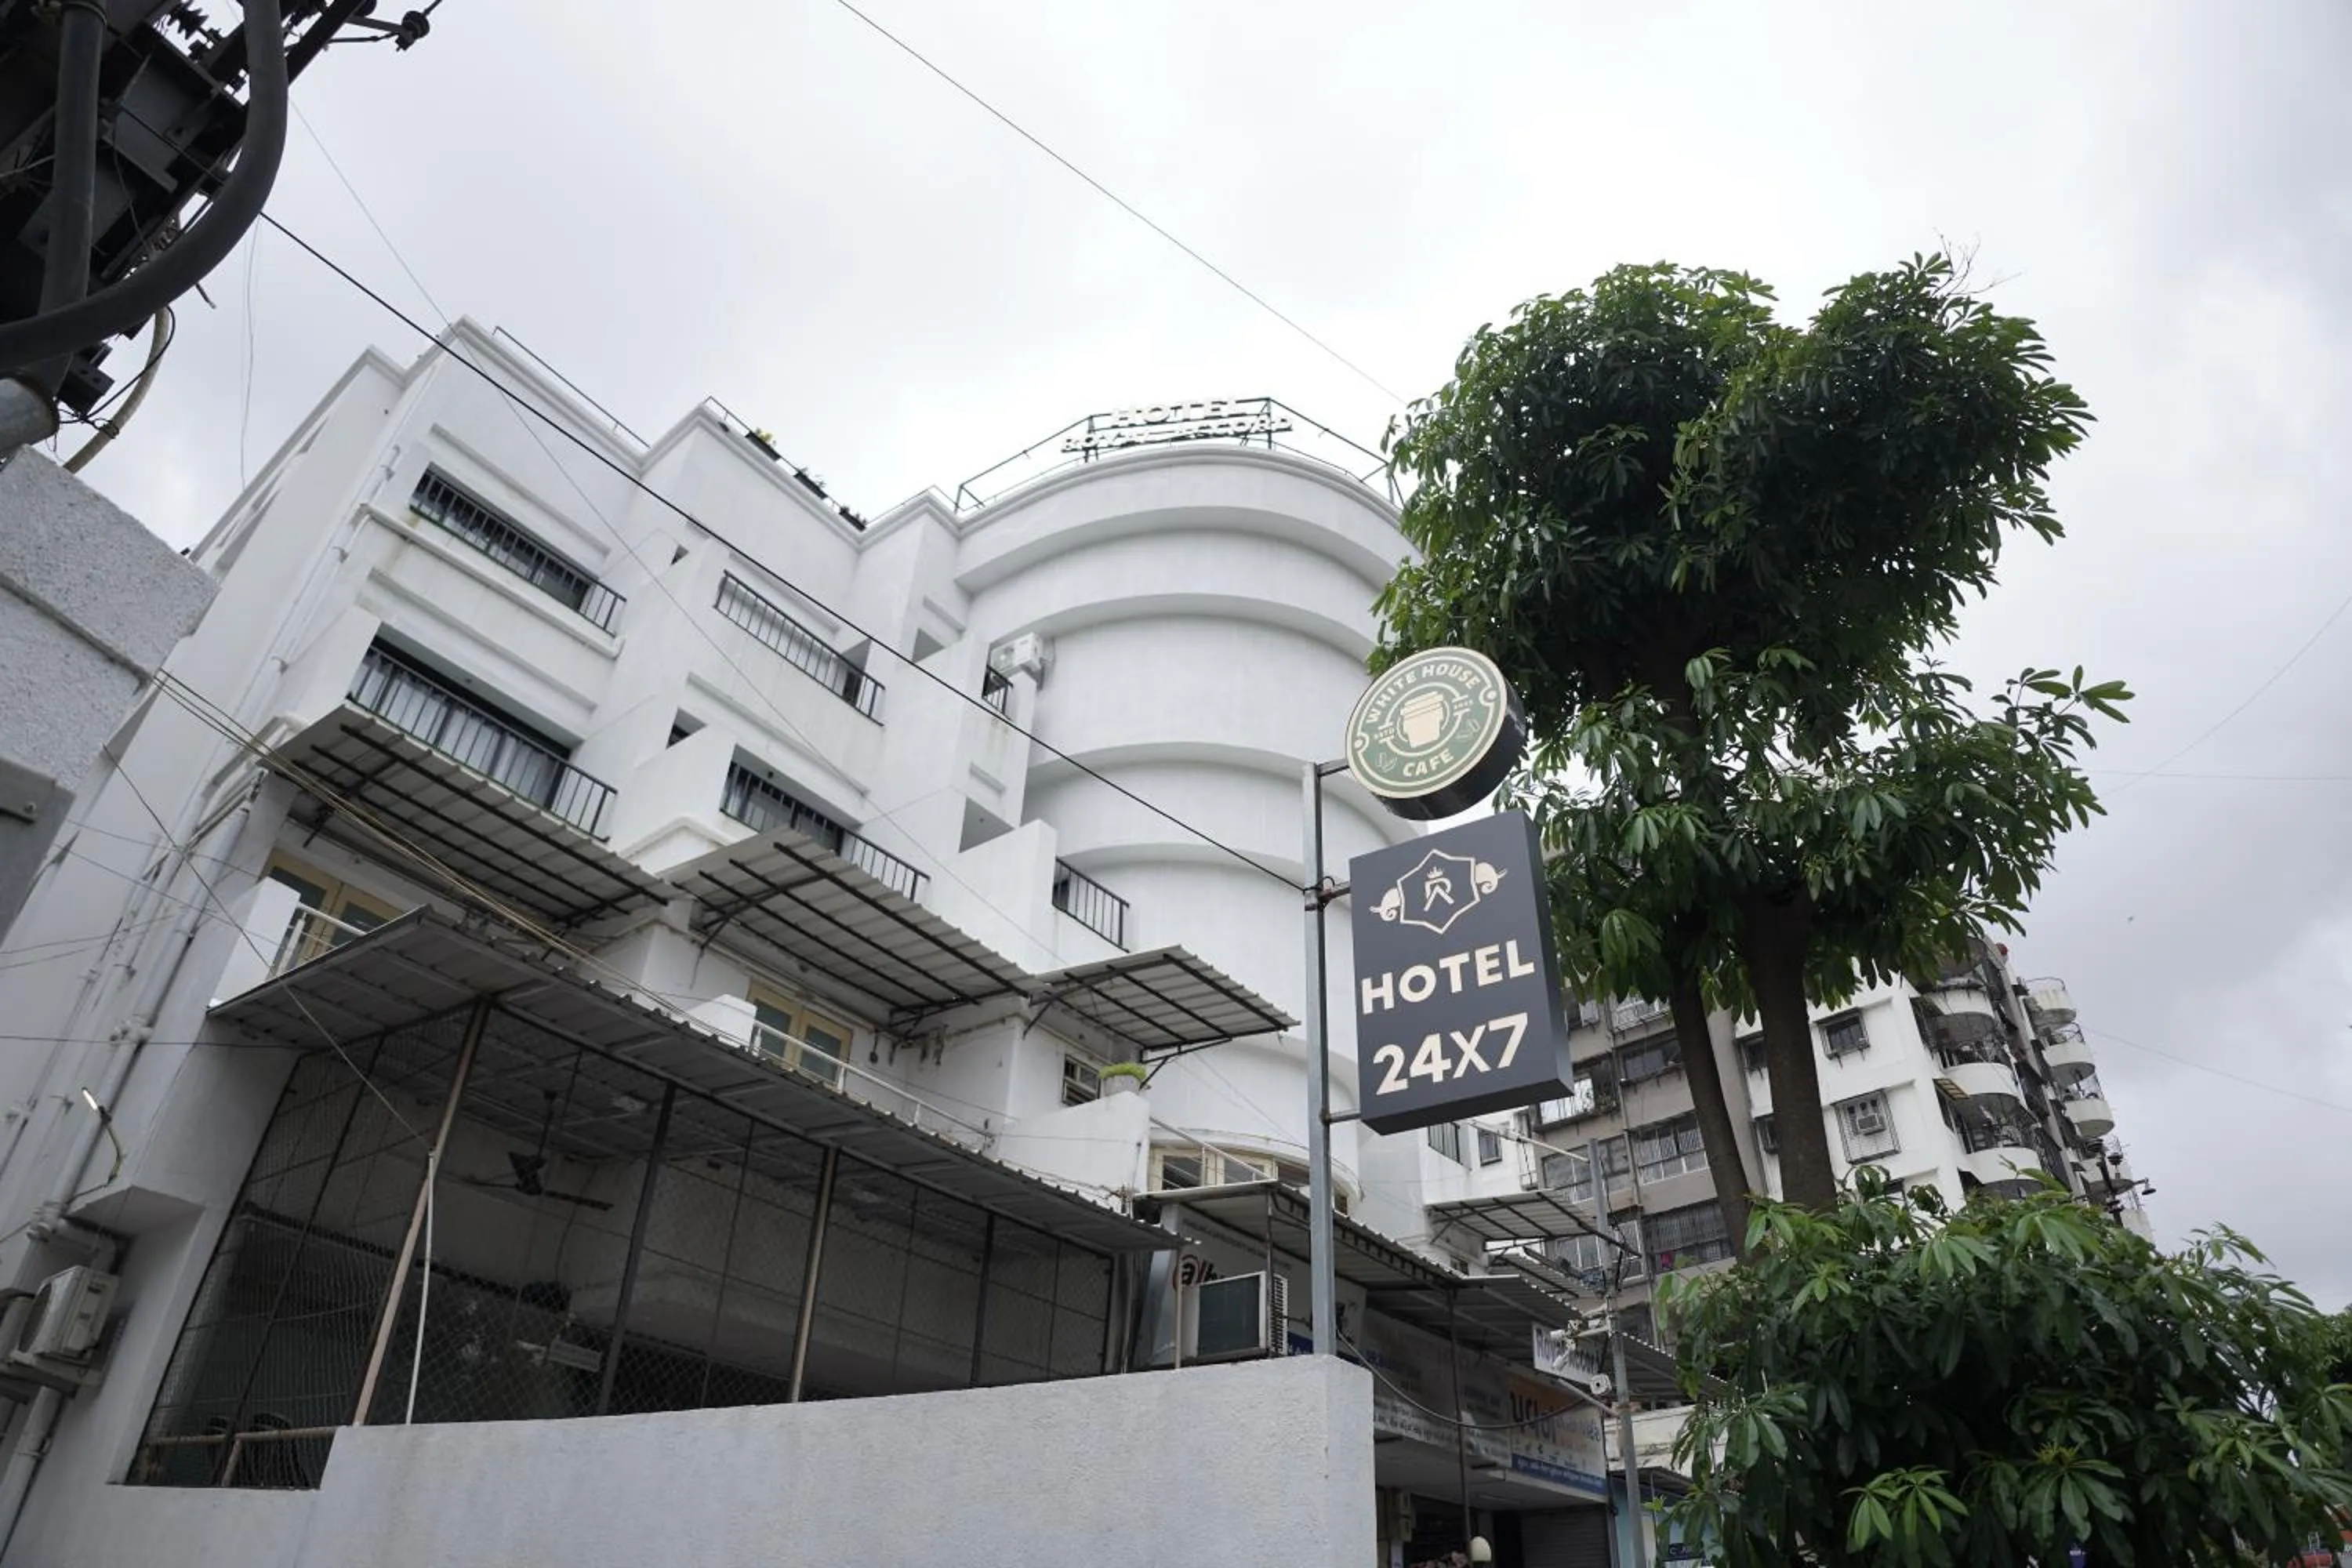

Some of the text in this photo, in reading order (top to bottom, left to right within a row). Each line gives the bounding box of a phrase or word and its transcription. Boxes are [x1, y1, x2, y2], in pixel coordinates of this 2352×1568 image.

[1110, 398, 1247, 428] HOTEL
[1366, 662, 1481, 724] WHITE HOUSE
[1402, 749, 1454, 777] CAFE
[1361, 939, 1535, 1014] HOTEL
[1373, 1012, 1528, 1096] 24X7
